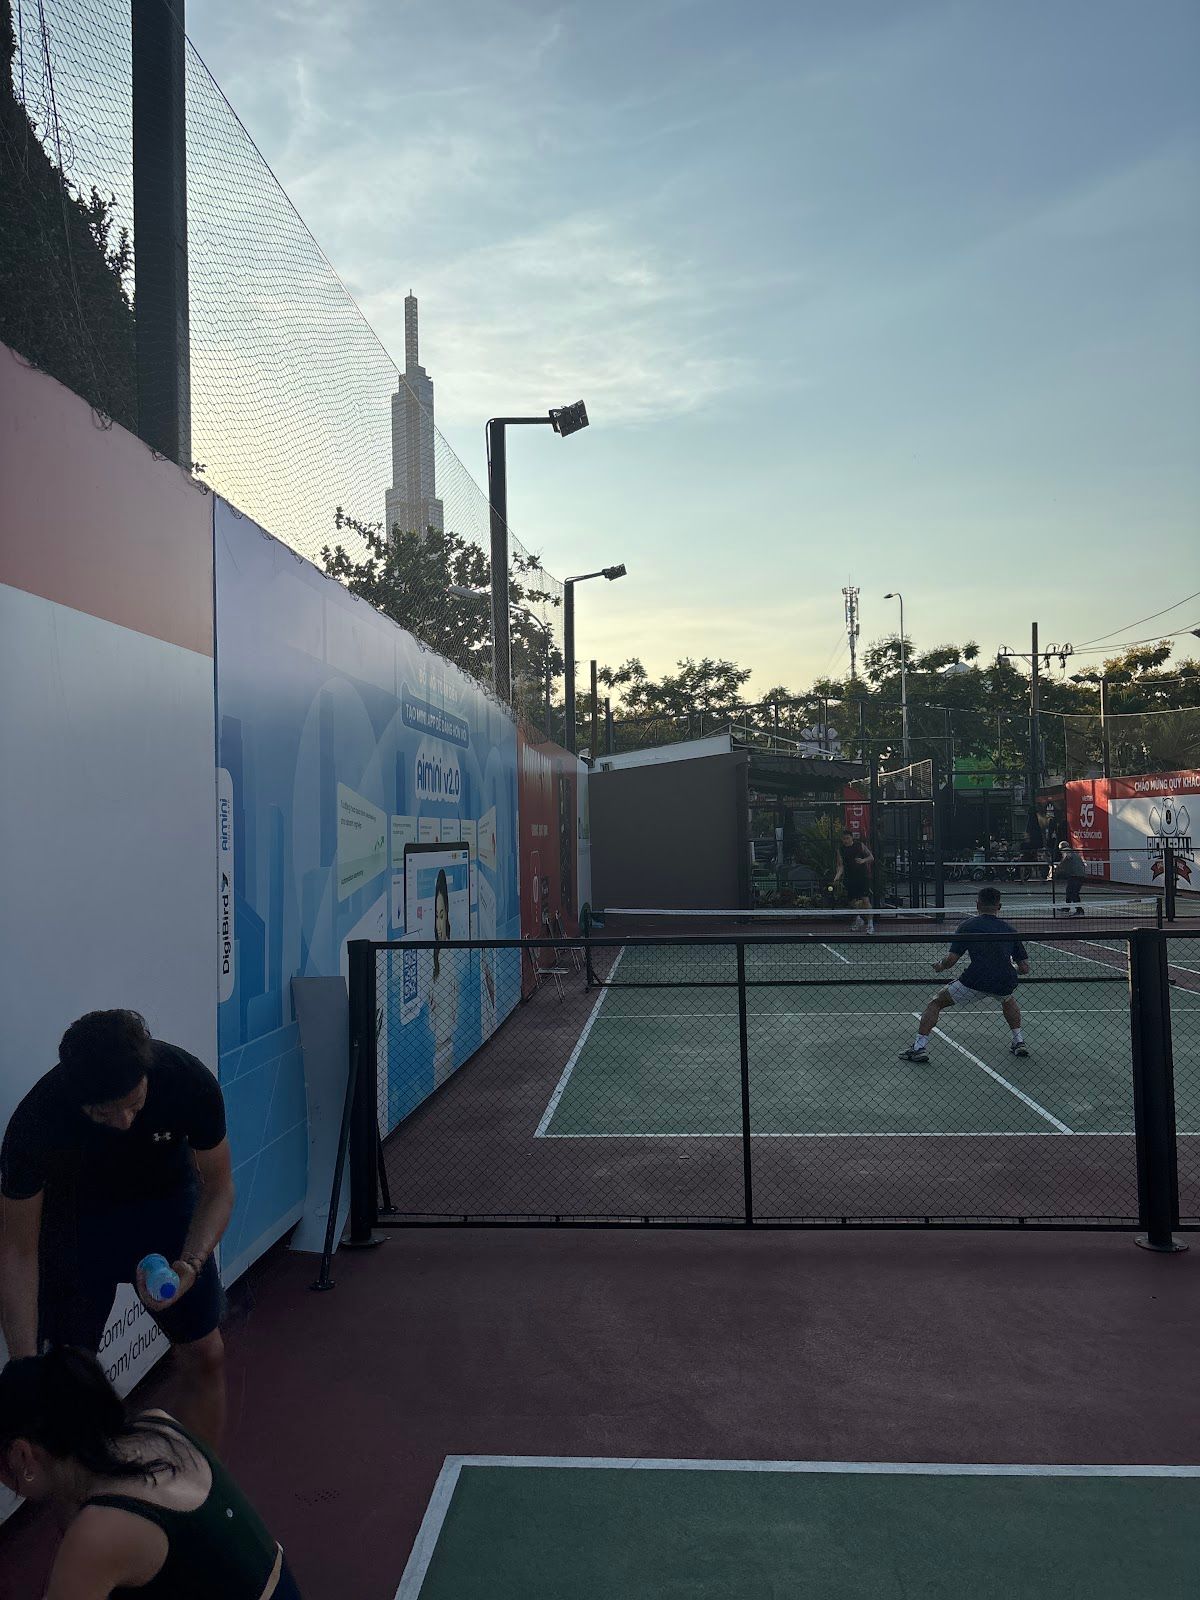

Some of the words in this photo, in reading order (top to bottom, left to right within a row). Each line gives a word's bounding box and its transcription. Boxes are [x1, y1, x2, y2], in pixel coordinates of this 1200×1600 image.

[443, 767, 460, 795] v2.0
[1134, 777, 1149, 791] CHÀO
[1168, 774, 1182, 791] QUÝ
[1080, 803, 1094, 828] 5G
[222, 894, 232, 975] DigiBird
